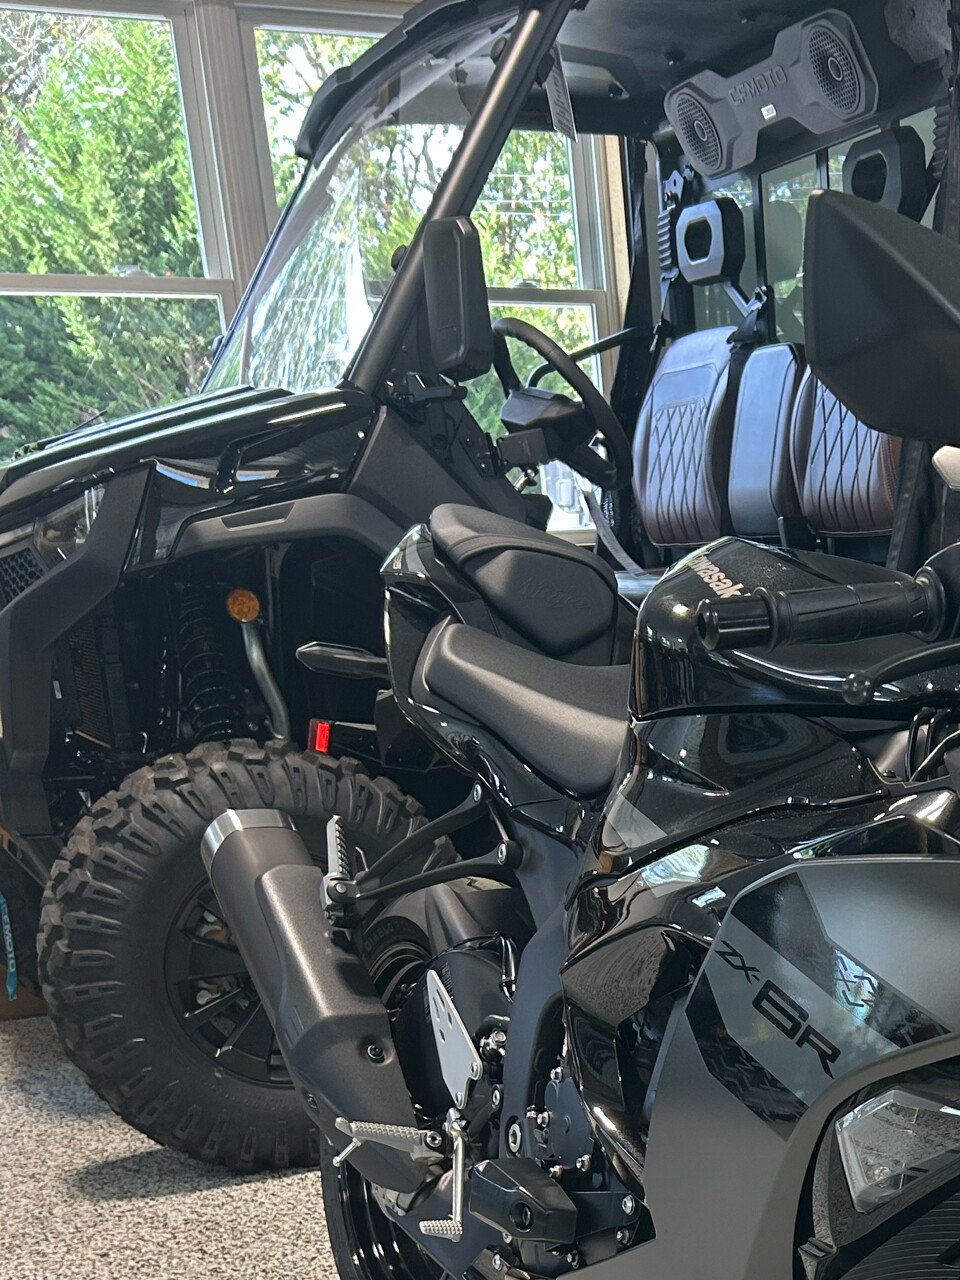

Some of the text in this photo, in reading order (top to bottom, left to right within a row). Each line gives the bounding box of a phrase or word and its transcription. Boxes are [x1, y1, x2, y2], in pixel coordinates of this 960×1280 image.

[729, 65, 787, 105] CFMOTO
[687, 553, 752, 599] awasak
[714, 940, 842, 1079] ZX-6R
